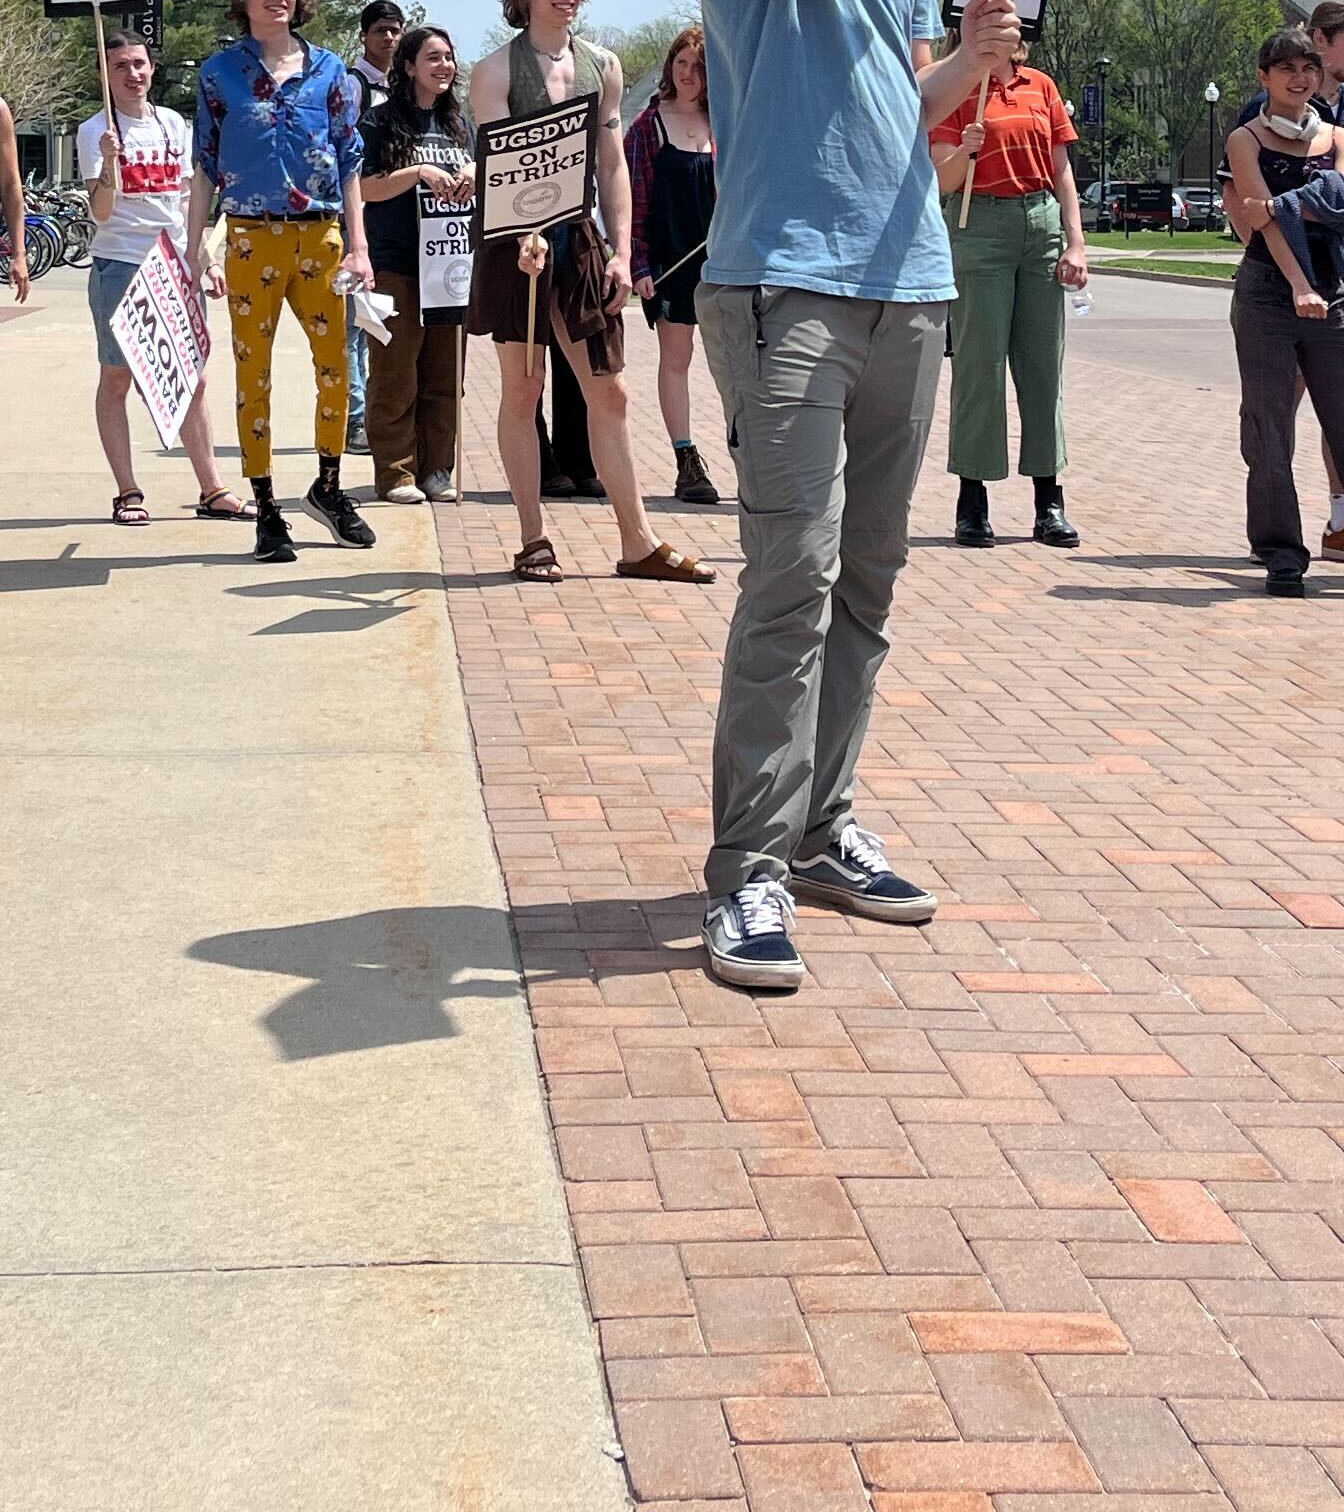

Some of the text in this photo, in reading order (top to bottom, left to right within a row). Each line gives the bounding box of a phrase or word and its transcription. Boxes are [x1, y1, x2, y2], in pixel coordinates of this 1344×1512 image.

[488, 113, 588, 151] UGSDW
[488, 149, 585, 187] STRIKE
[519, 145, 558, 167] ON
[426, 239, 473, 257] STRI
[446, 222, 470, 237] ON
[122, 297, 178, 419] BARGAIN
[129, 278, 185, 407] NOW!
